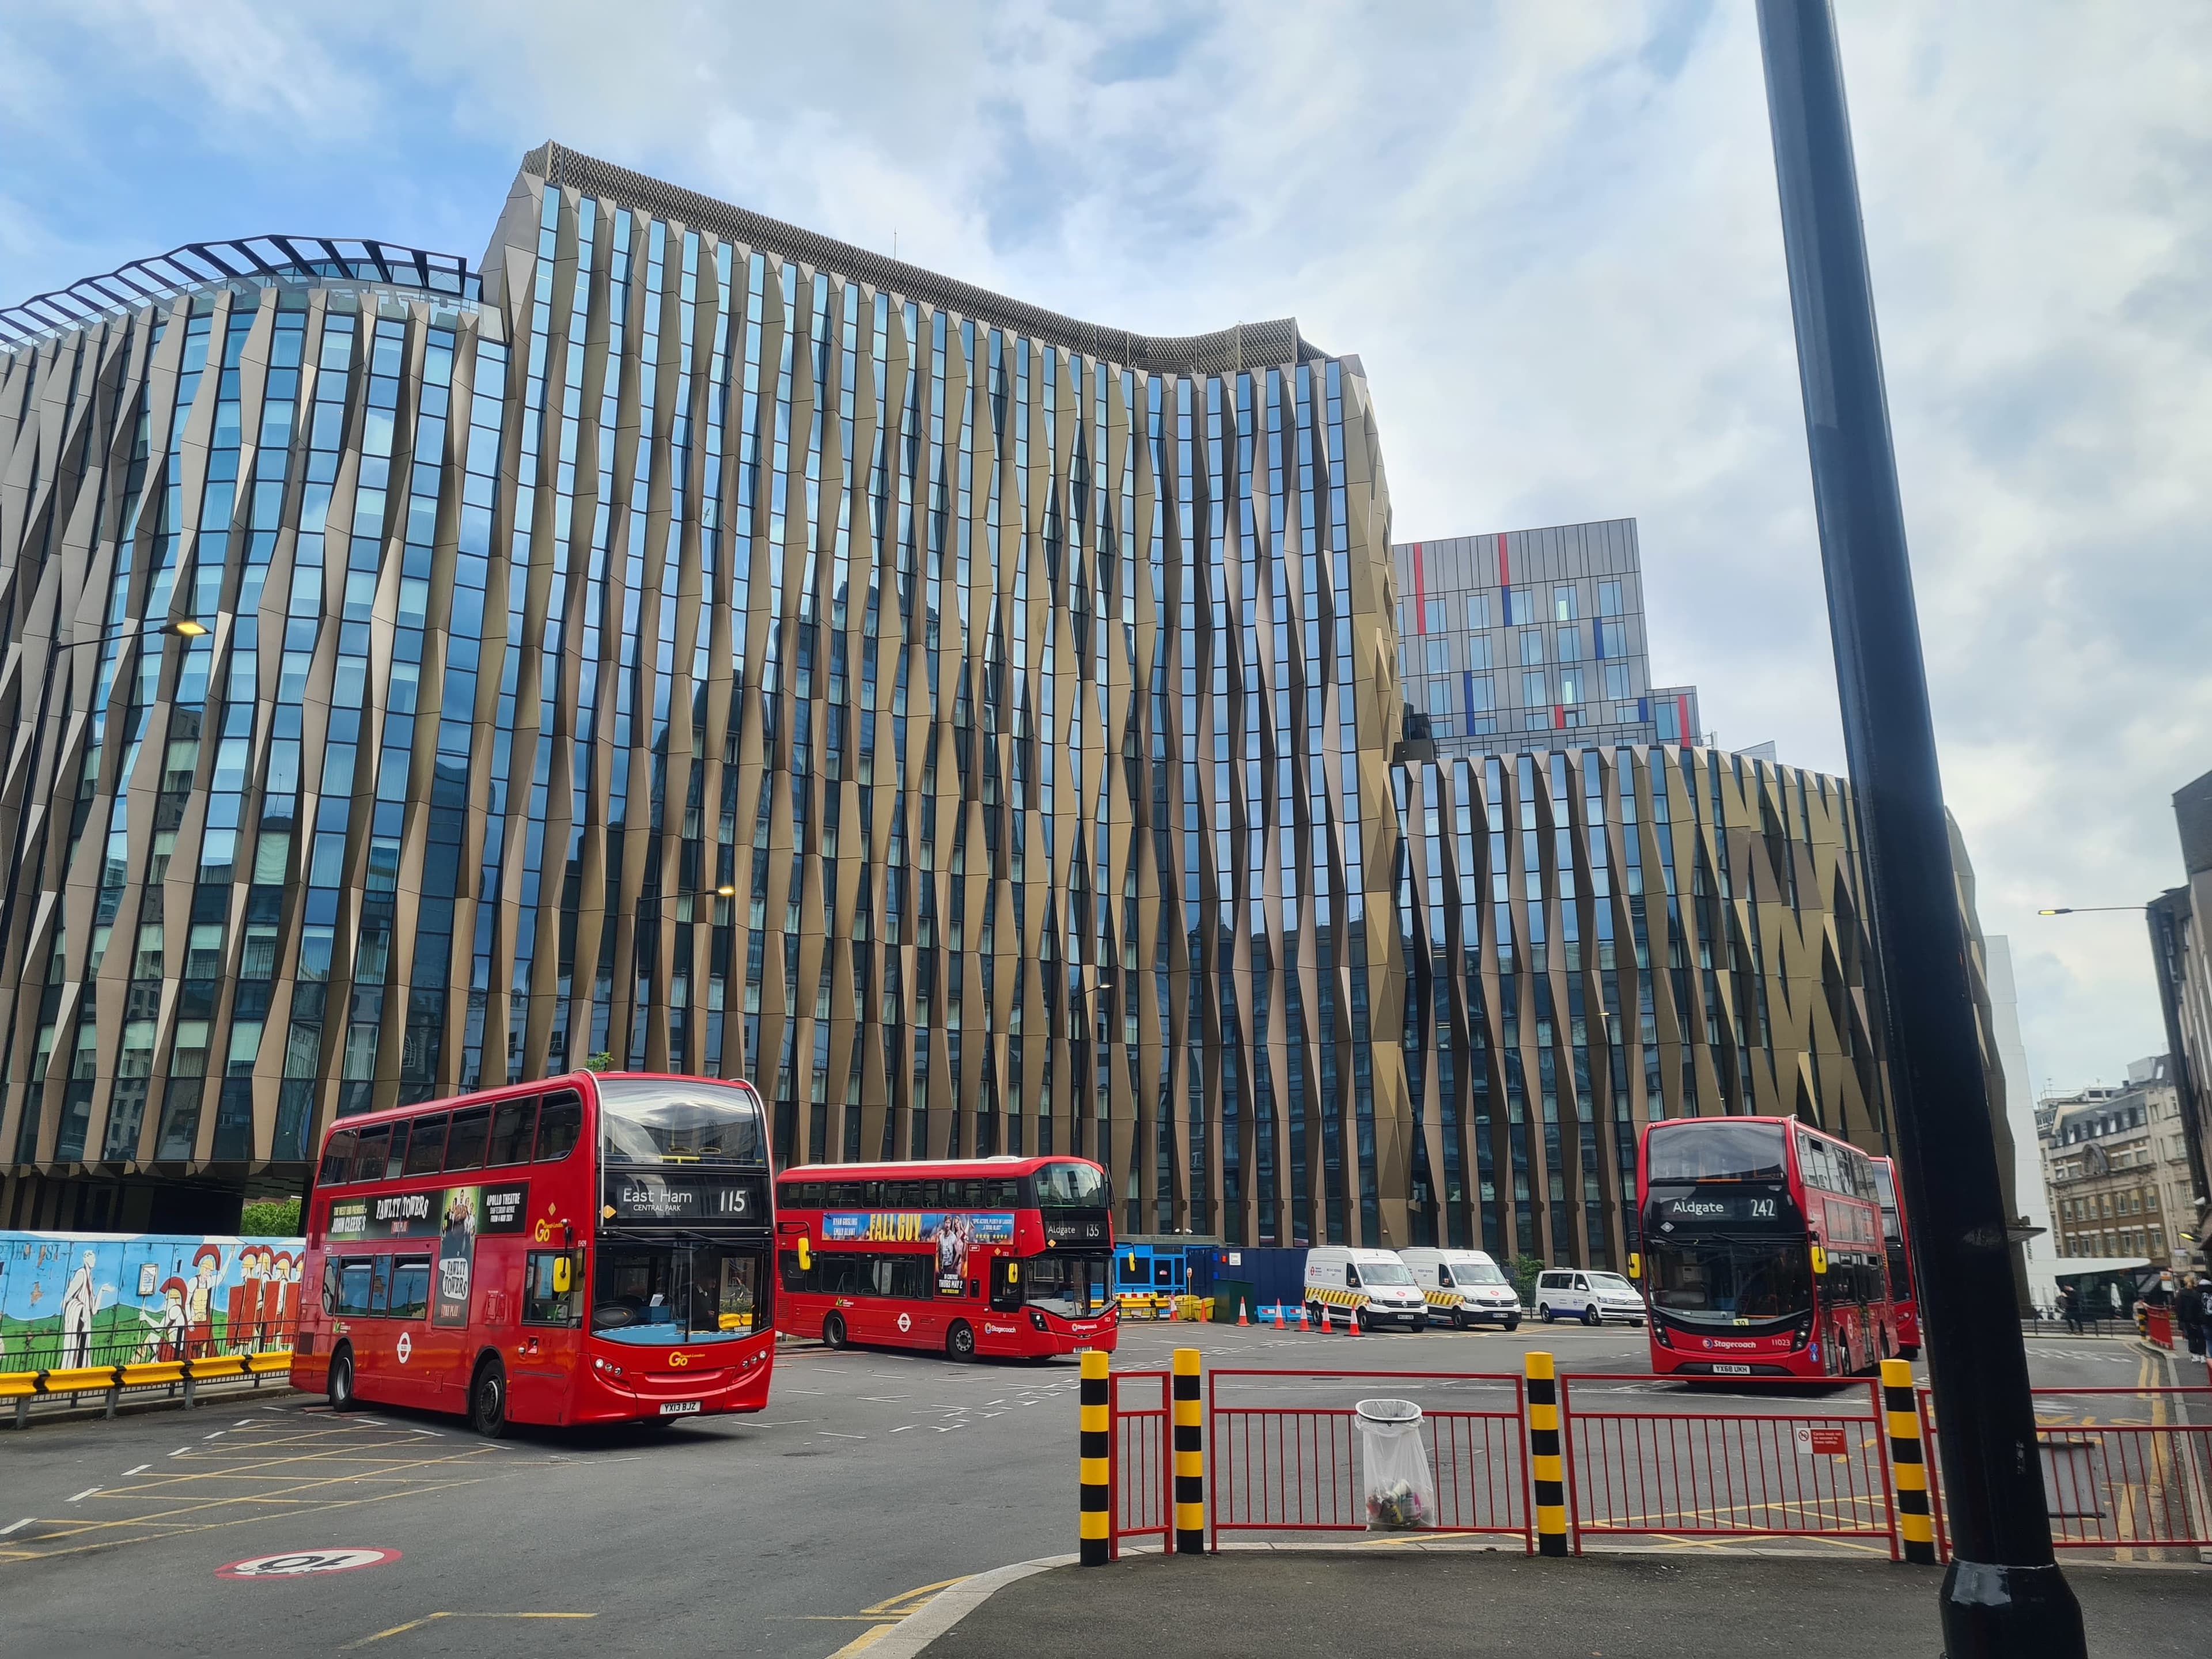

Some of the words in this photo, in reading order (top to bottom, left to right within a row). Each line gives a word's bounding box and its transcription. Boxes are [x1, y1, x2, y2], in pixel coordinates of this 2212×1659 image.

[486, 1194, 502, 1206] APOLLO
[502, 1192, 521, 1205] THEATRE
[623, 1188, 654, 1203] East
[660, 1189, 692, 1203] Ham
[720, 1190, 747, 1212] 115
[376, 1198, 402, 1220] FAWLTY
[402, 1195, 429, 1219] TOWERS
[1673, 1201, 1724, 1215] Aldgate
[1751, 1199, 1775, 1217] 242
[332, 1217, 345, 1233] JOHN
[535, 1218, 550, 1242] Go
[869, 1214, 895, 1240] FALL
[897, 1214, 922, 1241] GUY
[1048, 1226, 1075, 1236] Aldgate
[1086, 1224, 1099, 1237] 135
[447, 1261, 466, 1275] FAWLTY
[444, 1277, 468, 1297] TOWERS
[959, 1281, 963, 1289] 2
[1714, 1339, 1756, 1349] Stagecoach
[669, 1351, 688, 1366] Go
[665, 1403, 681, 1412] YX13
[682, 1402, 696, 1411] BJZ
